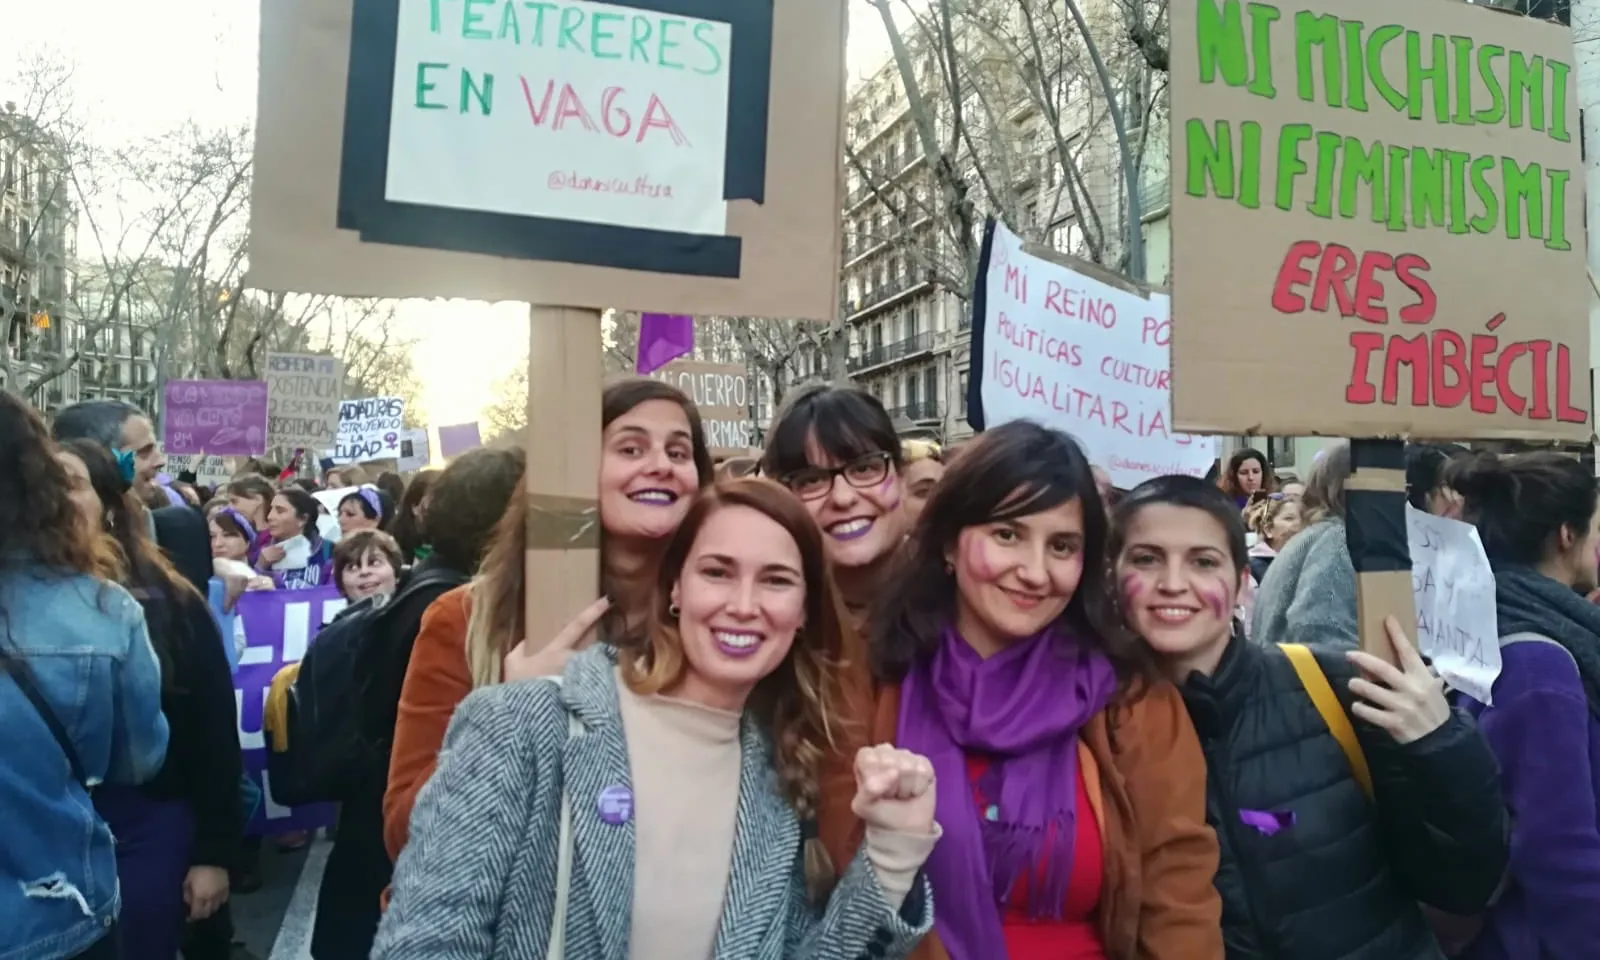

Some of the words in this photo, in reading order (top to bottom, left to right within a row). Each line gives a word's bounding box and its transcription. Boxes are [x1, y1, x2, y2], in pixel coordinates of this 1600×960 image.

[420, 0, 723, 76] TEATRERES
[1196, 0, 1281, 99] NI
[1294, 10, 1572, 143] MICHISMI
[413, 62, 494, 117] EN
[518, 74, 693, 148] VAGA
[1185, 118, 1262, 210] NI
[1275, 122, 1572, 252] FIMINISMI
[1271, 239, 1438, 325] ERES
[1345, 311, 1588, 424] IMBÉCIL
